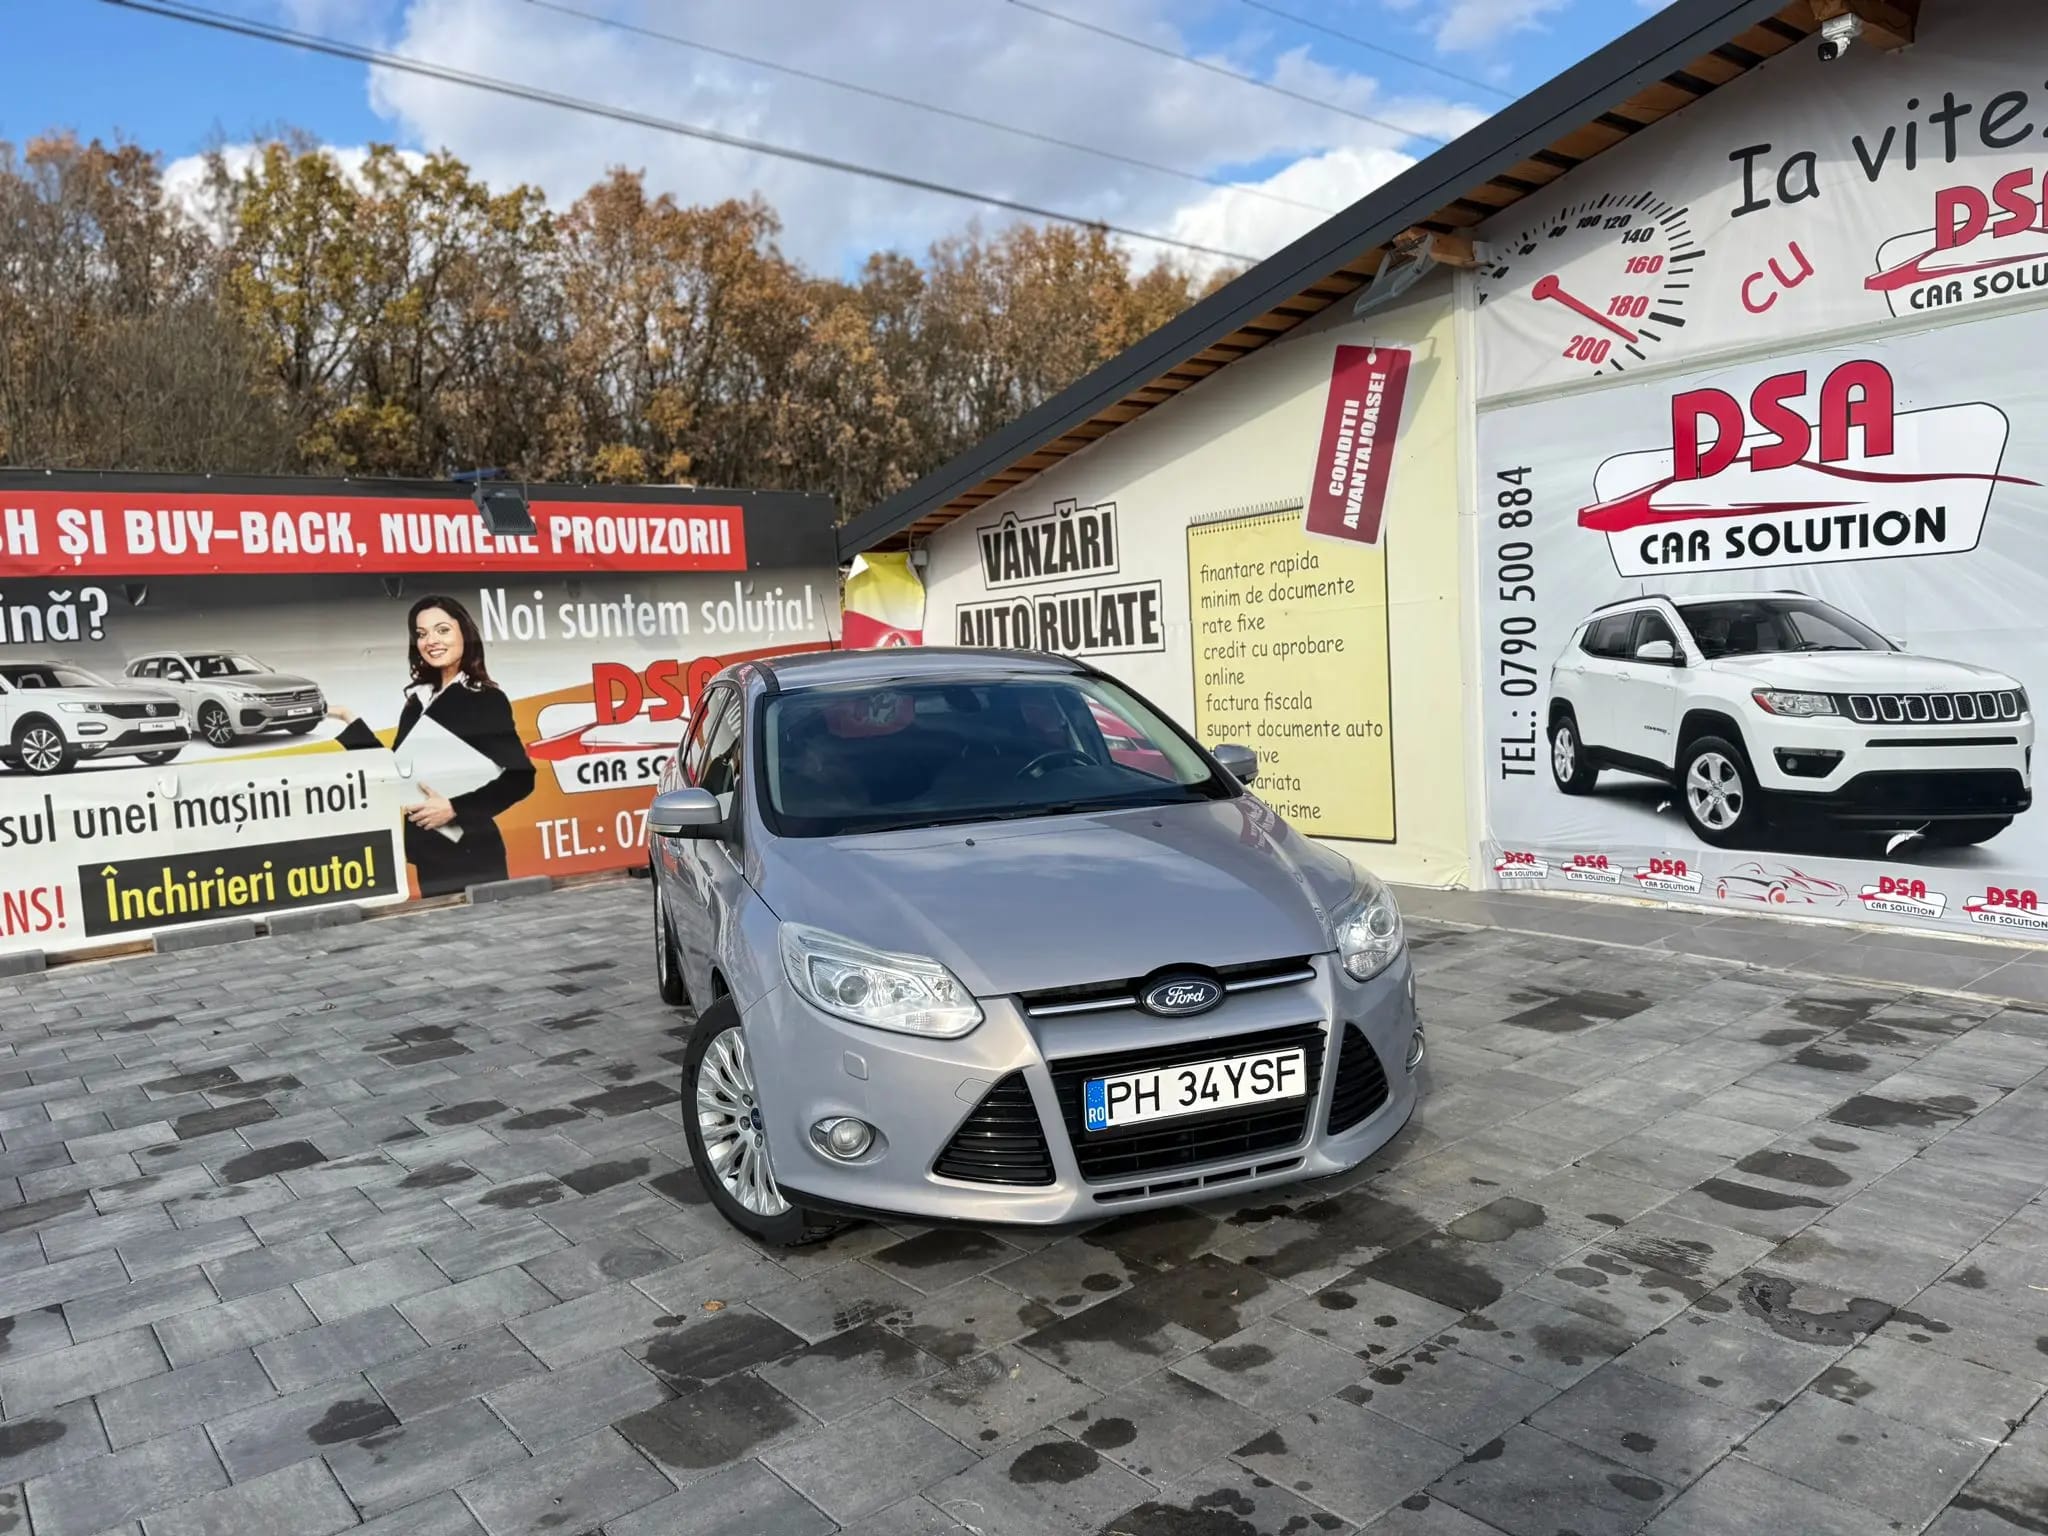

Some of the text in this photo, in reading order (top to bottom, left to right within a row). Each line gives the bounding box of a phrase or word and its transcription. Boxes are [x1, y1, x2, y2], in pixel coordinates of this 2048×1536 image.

[1729, 80, 2048, 218] Ia vite
[1576, 214, 1602, 229] 100
[1602, 214, 1632, 230] 120
[1935, 167, 2048, 251] DS
[1621, 227, 1655, 244] 140
[1624, 255, 1664, 274] 160
[1741, 241, 1815, 314] cu
[1606, 295, 1650, 318] 180
[1910, 280, 1962, 310] CAR
[1562, 334, 1612, 364] 200
[1671, 359, 1894, 482] DSA
[1328, 399, 1360, 497] CONDITII
[1342, 371, 1387, 530] AVANTAJOASE!
[0, 508, 39, 555] H
[56, 508, 108, 567] ȘI
[123, 509, 368, 557] BUY-BACK,
[549, 515, 732, 555] PROVIZORII
[982, 507, 1114, 583] VÂNZĂRI
[1640, 506, 1946, 565] CAR SOLUTION
[1200, 550, 1319, 584] finantare rapida
[1201, 577, 1356, 609] minim de documente
[479, 580, 815, 642] Noi suntem soluția!
[959, 589, 1160, 651] AUTO RULATE
[1202, 613, 1266, 634] rate fixe
[1496, 466, 1537, 780] TEL.: 0790 500 884
[1203, 635, 1345, 662] credit cu aprobare
[1204, 667, 1245, 686] online
[1206, 690, 1313, 712] factura fiscala
[1207, 719, 1383, 742] suport documente auto
[577, 759, 627, 785] CAR
[0, 769, 368, 848] sul unei mașini noi!
[535, 817, 607, 860] TEL.:
[1573, 854, 1609, 869] DSA
[1649, 858, 1687, 876] DSA
[100, 846, 376, 923] Închirieri auto!
[1585, 873, 1616, 883] SOLUTION
[1659, 882, 1696, 892] SOLUTION
[1879, 876, 1926, 899] DSA
[0, 885, 66, 937] NS!
[1871, 902, 1935, 916] CAR SOLUTION
[1986, 886, 2038, 910] DSA
[1978, 914, 2048, 929] CAR SOLUTION
[1165, 985, 1205, 1006] Ford
[1107, 1054, 1300, 1120] PH 34YSF
[1088, 1107, 1105, 1121] RO
